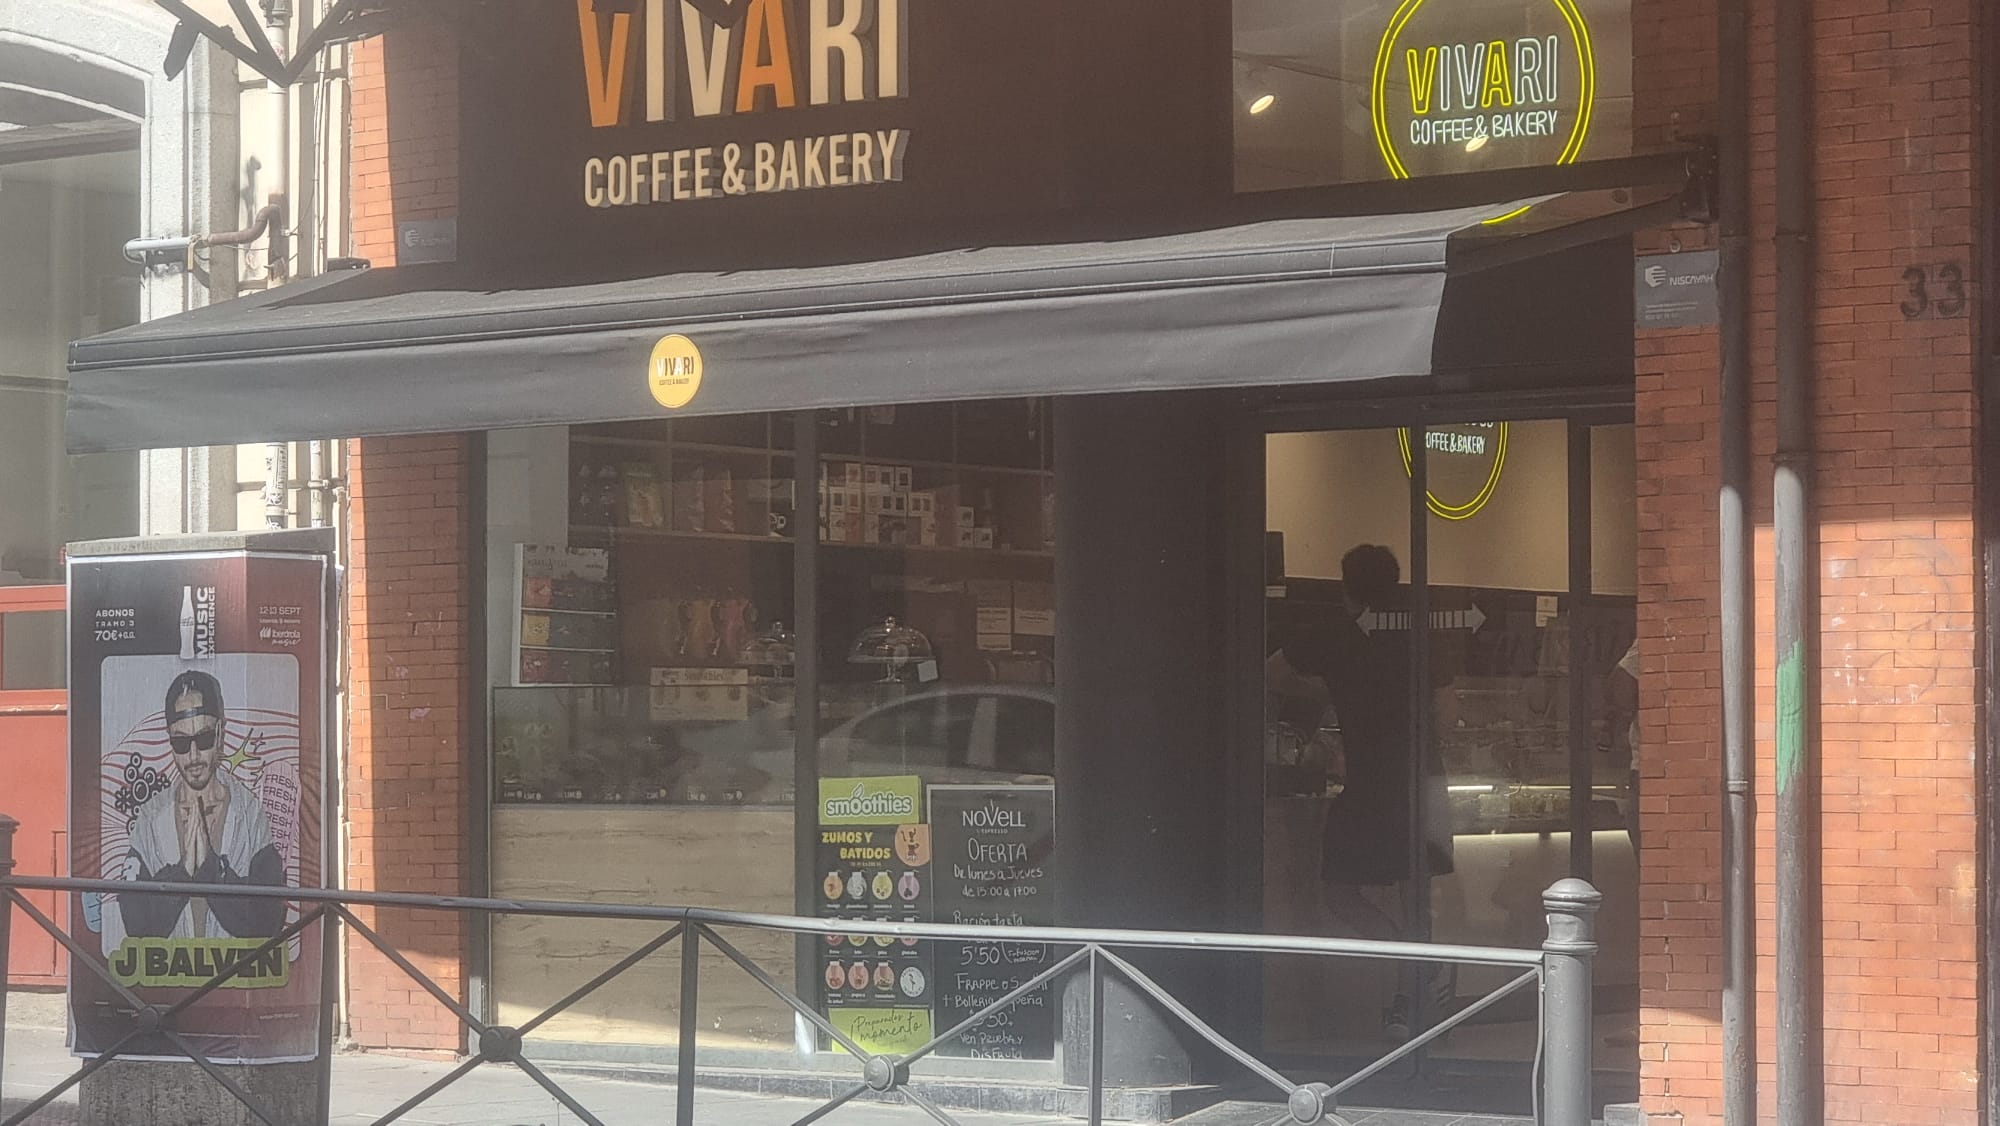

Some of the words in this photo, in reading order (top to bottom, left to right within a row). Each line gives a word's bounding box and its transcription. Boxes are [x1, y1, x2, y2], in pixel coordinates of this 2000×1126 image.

[578, 0, 899, 127] VIVARI
[1407, 35, 1558, 114] VIVARI
[1411, 118, 1473, 145] COFFEE
[1474, 115, 1488, 139] &
[1492, 110, 1558, 137] BAKERY
[585, 147, 713, 207] COFFEE
[722, 142, 748, 195] &
[754, 129, 900, 193] BAKERY
[1900, 264, 1966, 317] 33
[656, 356, 695, 377] VIVARI
[1426, 431, 1449, 452] OFFEE
[1458, 434, 1486, 455] BAKERY
[95, 608, 135, 617] ABONOS
[279, 606, 301, 615] SEPT
[197, 587, 208, 659] MUSIC
[208, 586, 216, 659] EXPERIENCE
[265, 774, 298, 794] FRESH
[263, 786, 297, 806] FRESH
[825, 792, 913, 816] smoothies
[262, 798, 295, 817] FRESH
[265, 811, 293, 829] RESH
[821, 831, 862, 843] ZUMOS
[863, 831, 873, 843] Y
[840, 847, 891, 859] BATIDOS
[968, 837, 1028, 863] OFERTA
[968, 864, 996, 880] lunes
[962, 884, 975, 897] de
[115, 947, 137, 977] J
